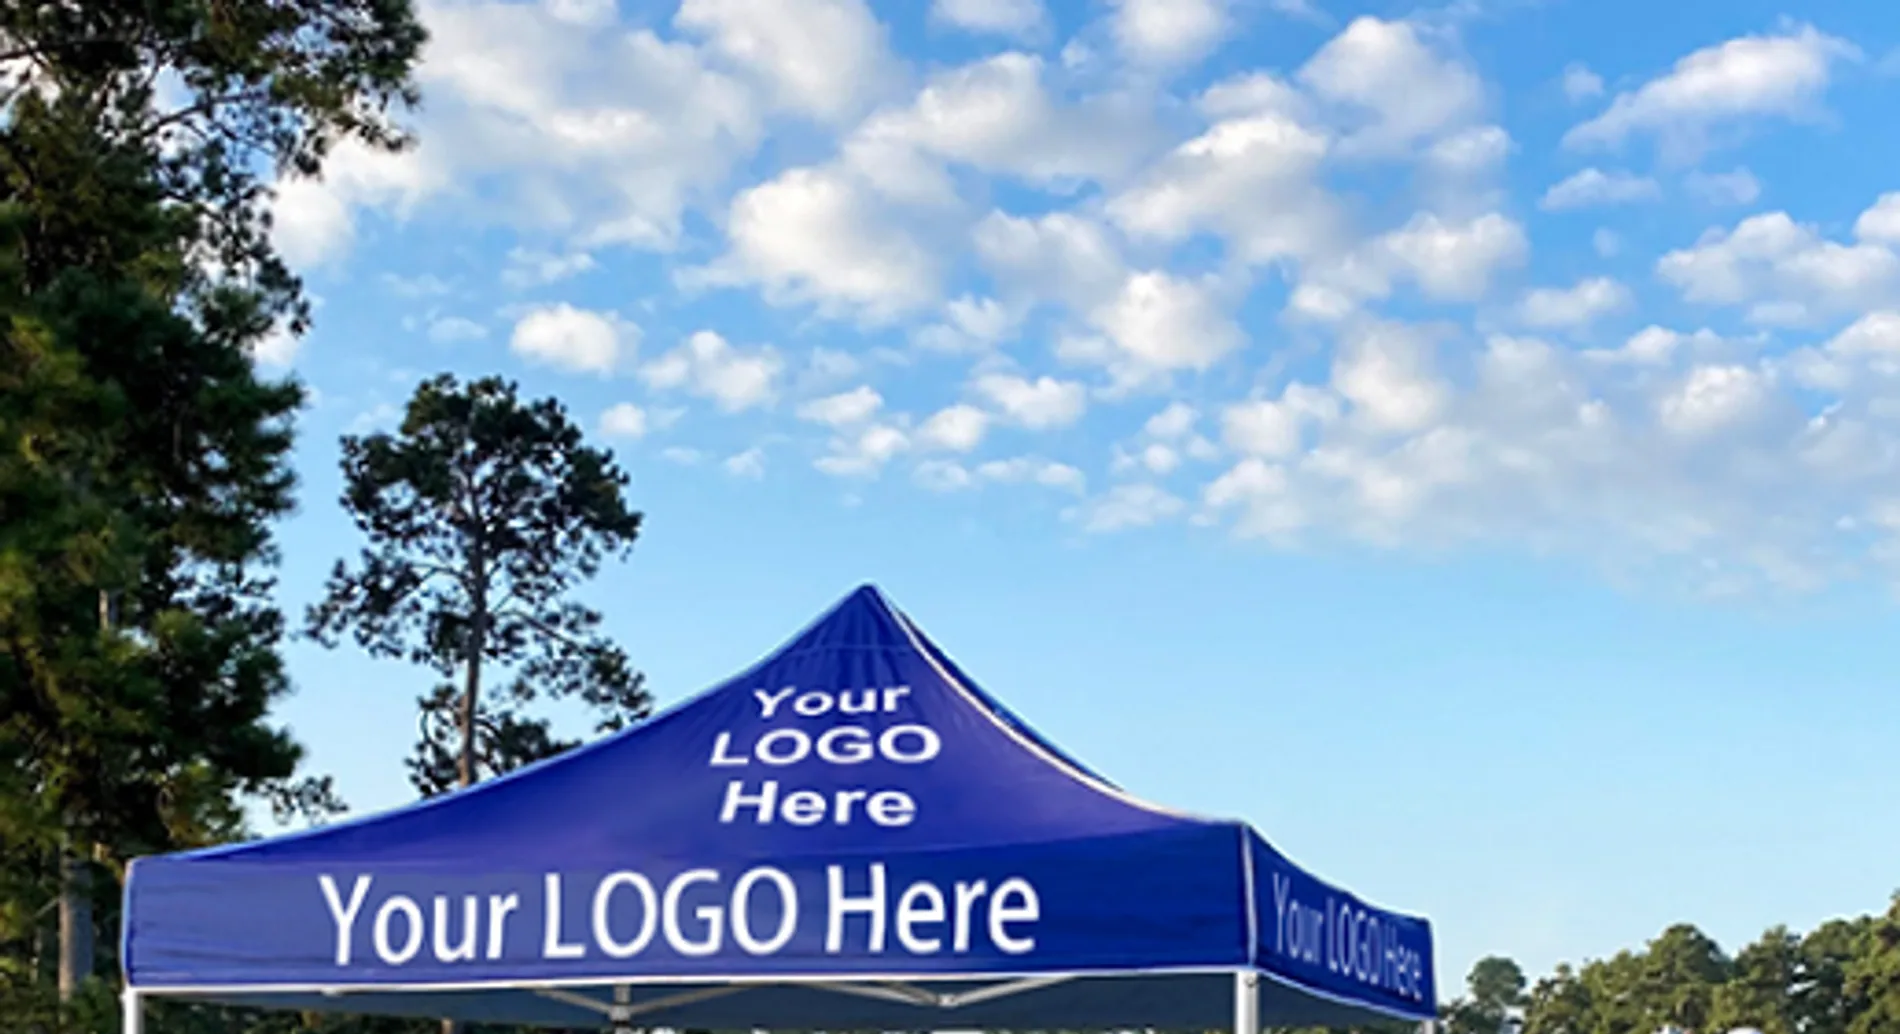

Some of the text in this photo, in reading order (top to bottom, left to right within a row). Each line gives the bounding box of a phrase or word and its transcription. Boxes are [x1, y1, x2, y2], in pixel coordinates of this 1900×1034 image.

[755, 686, 911, 718] Your
[710, 724, 942, 766] LOGO
[720, 780, 916, 827] Here
[318, 863, 1040, 967] Your LOGO Here
[1326, 896, 1383, 985] LOGO
